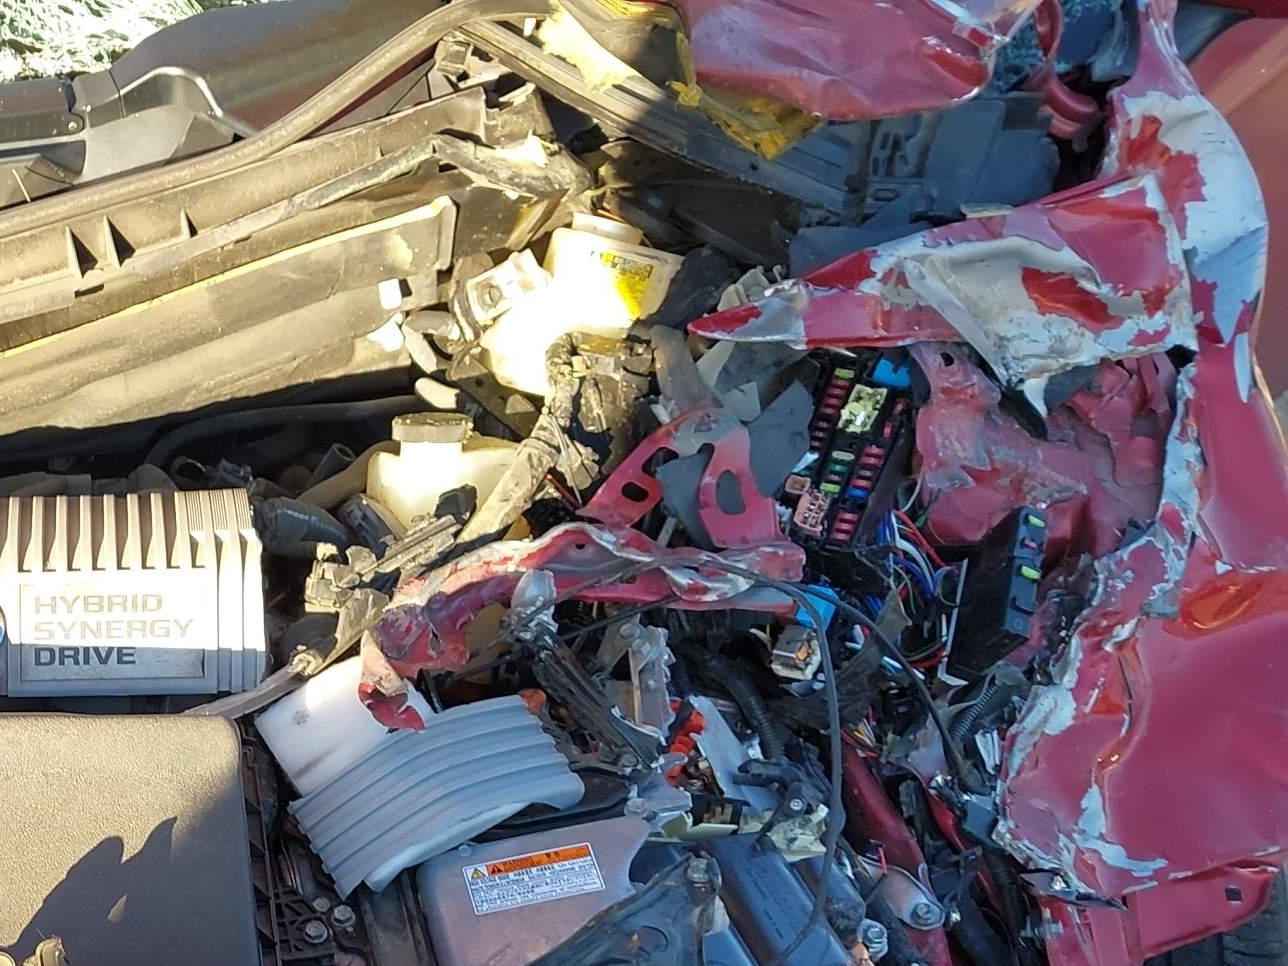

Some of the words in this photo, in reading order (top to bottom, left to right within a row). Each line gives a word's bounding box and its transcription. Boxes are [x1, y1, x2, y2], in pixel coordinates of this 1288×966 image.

[34, 593, 164, 616] HYBRID
[33, 618, 194, 641] SYNERGY
[34, 646, 138, 667] DRIVE
